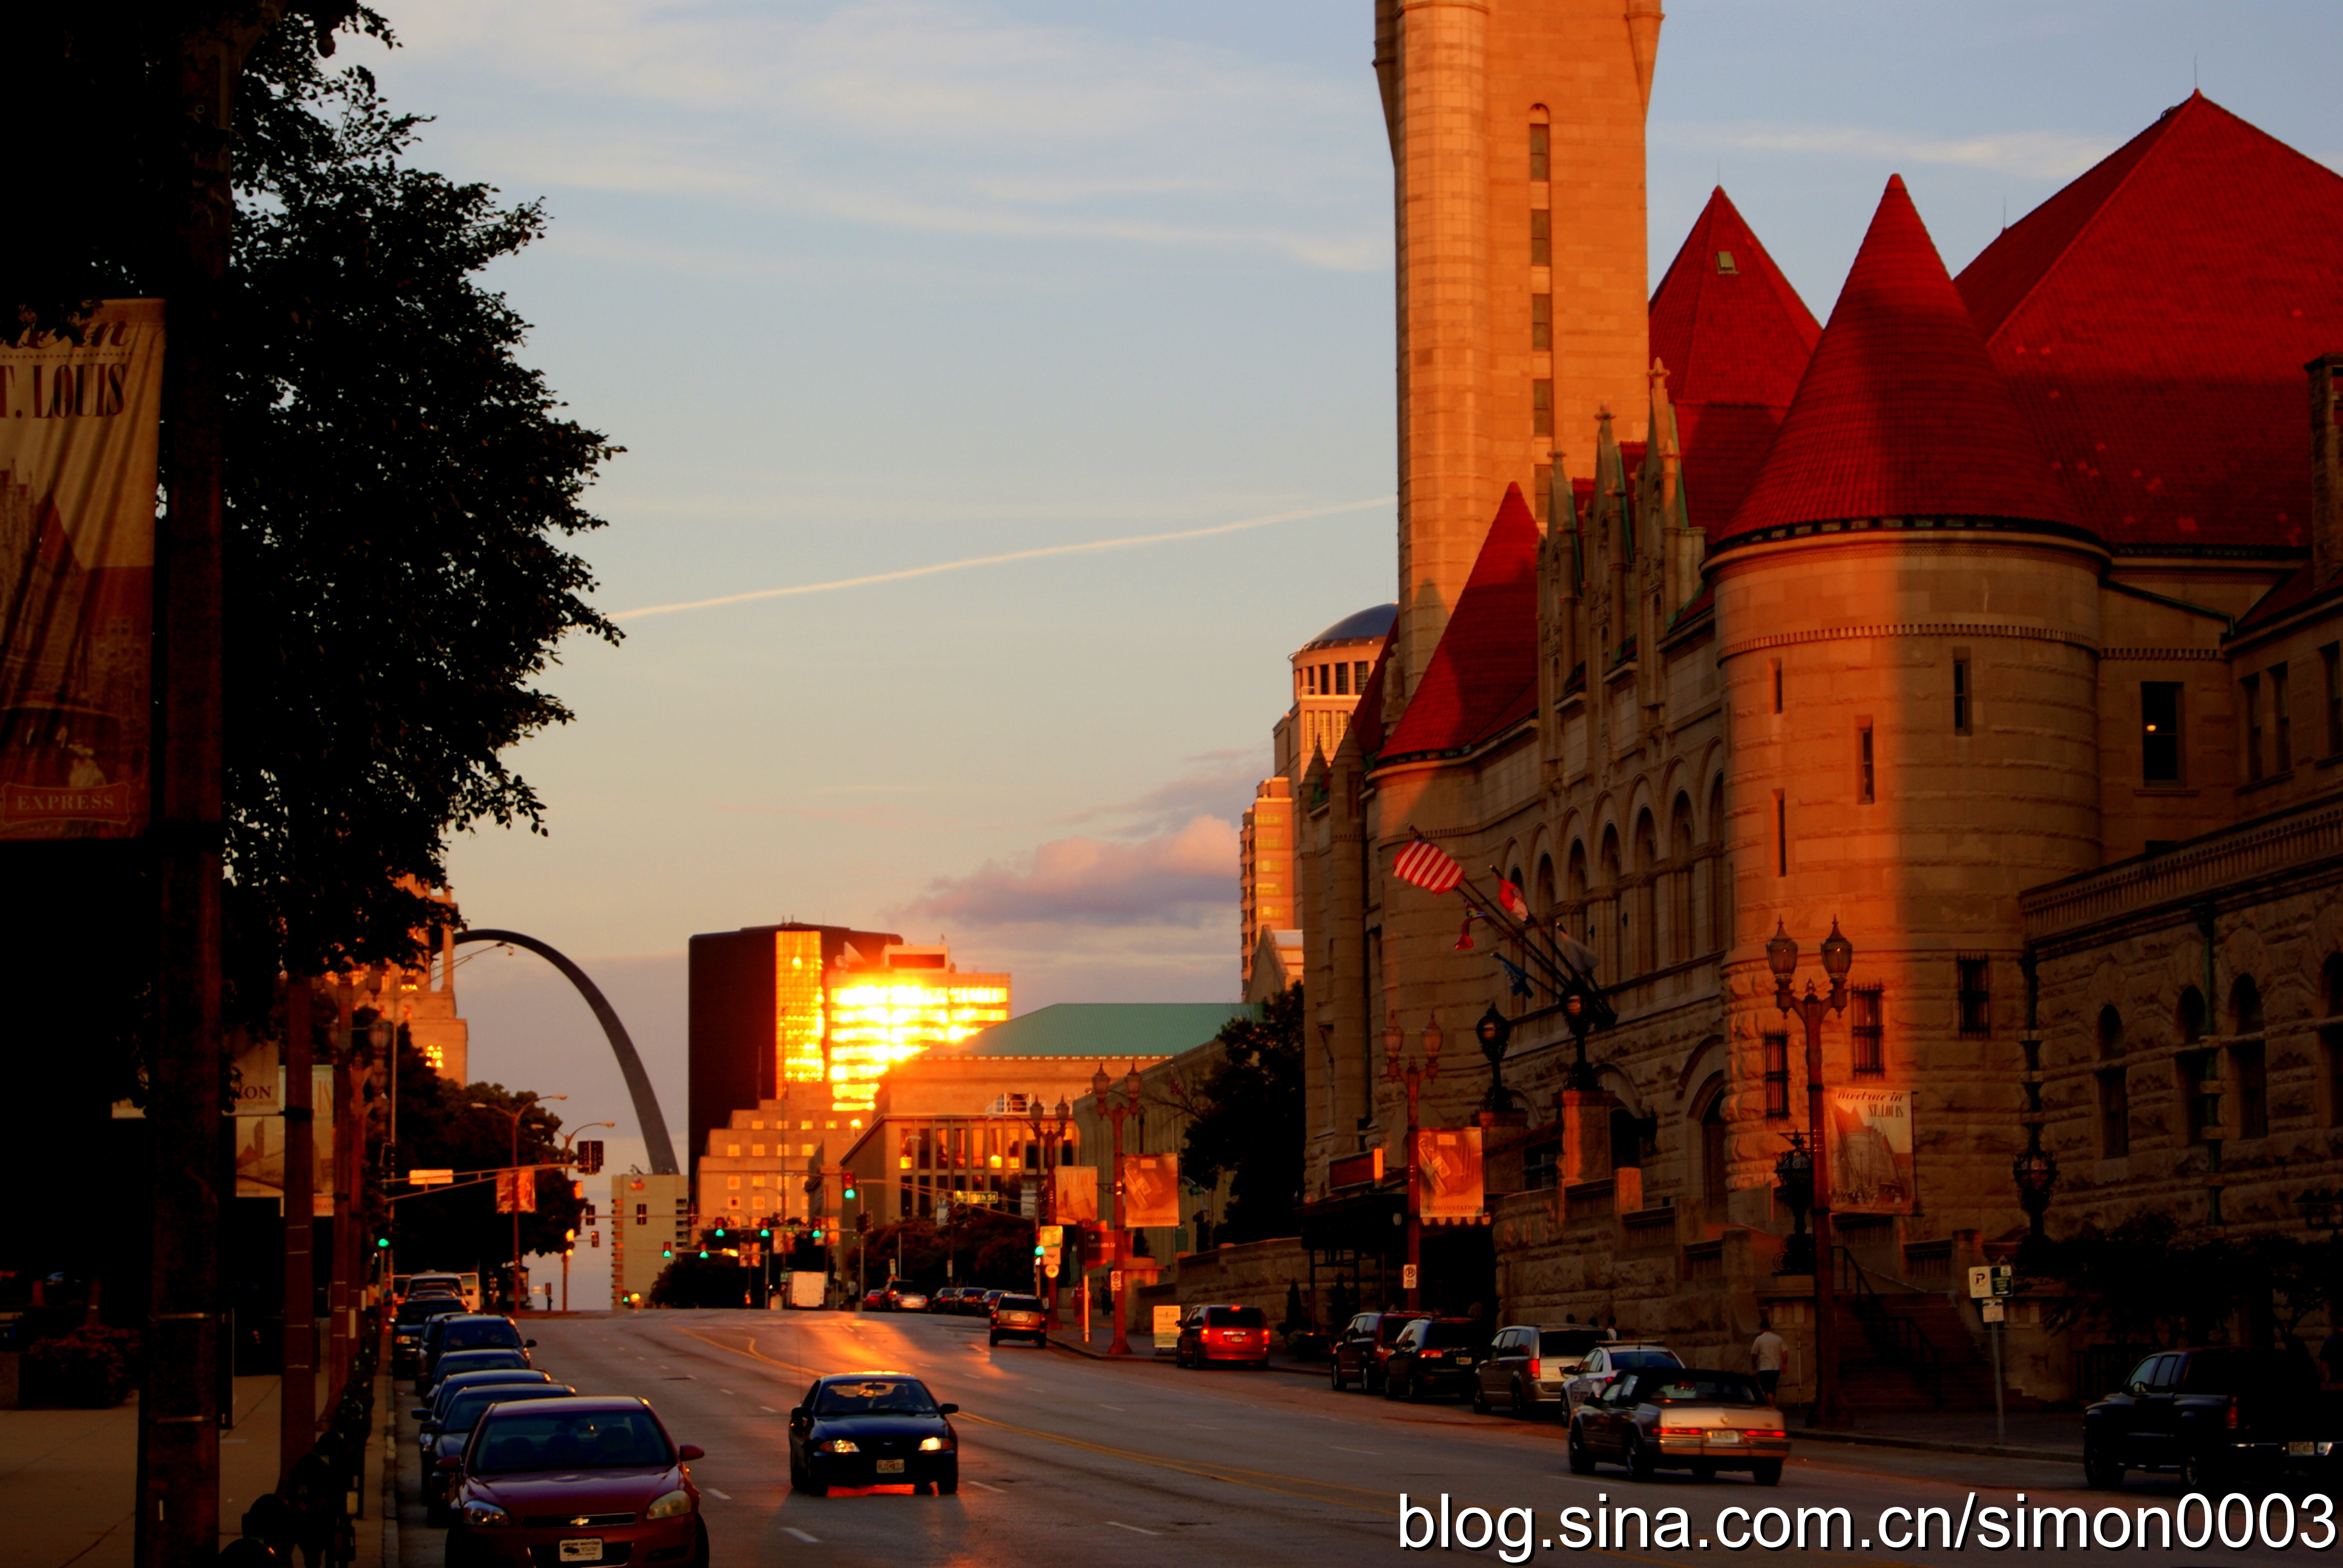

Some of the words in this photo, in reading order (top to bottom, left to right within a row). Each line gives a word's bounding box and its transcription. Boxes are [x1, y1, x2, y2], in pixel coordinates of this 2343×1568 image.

[33, 363, 126, 419] LOUIS
[17, 794, 114, 810] EXPRESS
[1890, 1092, 1903, 1101] in
[1881, 1105, 1904, 1118] LOUIS
